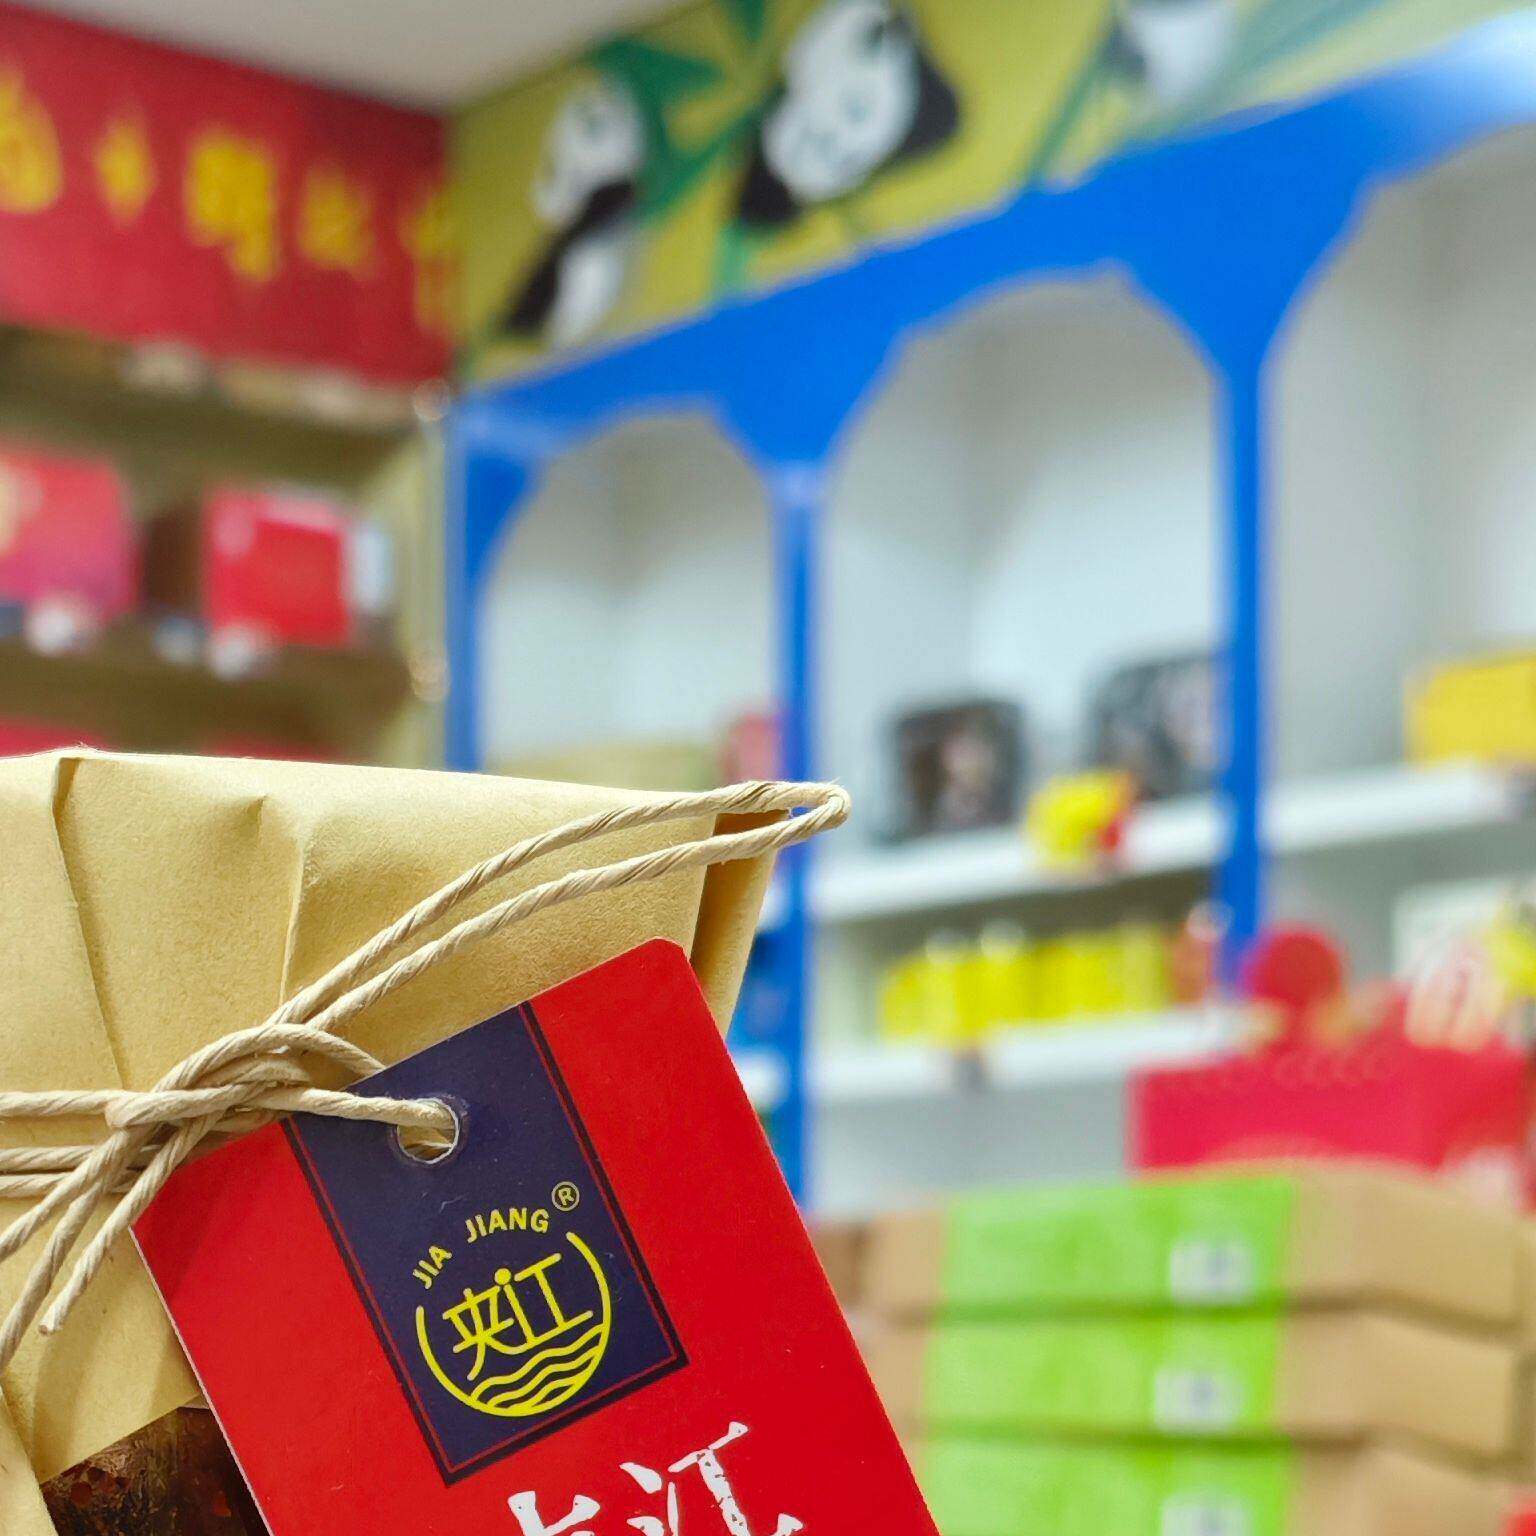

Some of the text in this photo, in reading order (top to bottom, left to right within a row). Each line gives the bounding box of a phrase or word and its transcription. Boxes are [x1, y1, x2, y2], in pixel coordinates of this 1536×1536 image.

[413, 1246, 452, 1289] JIA
[465, 1207, 549, 1243] JIANG
[442, 1253, 594, 1380] 夹江
